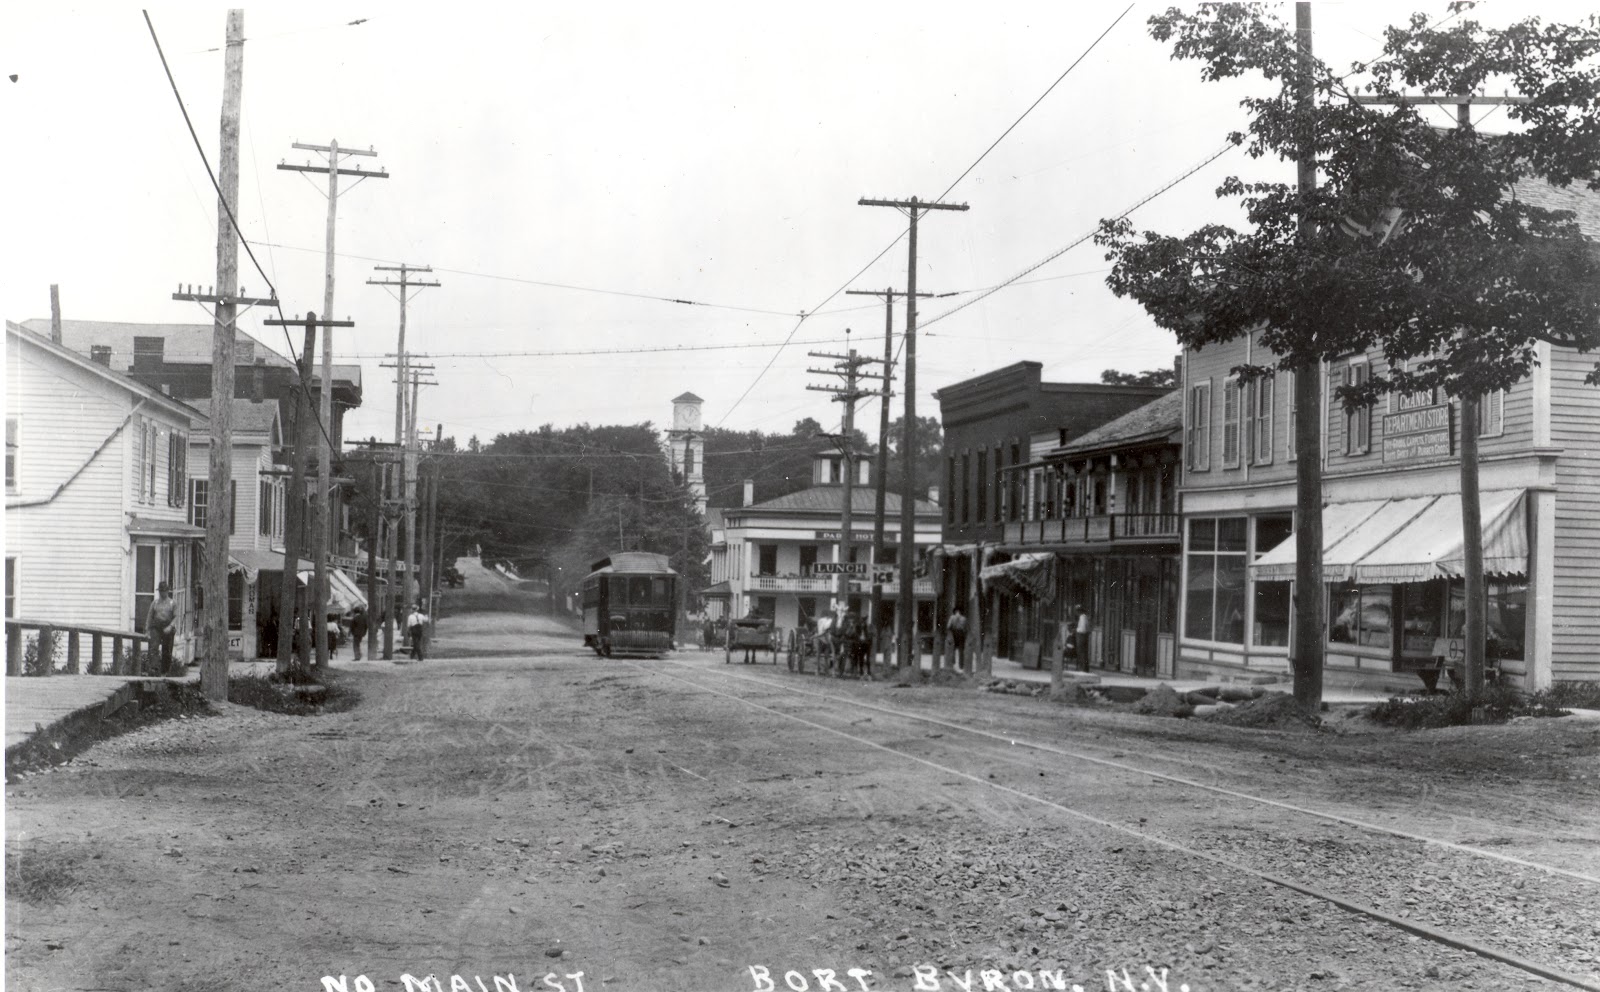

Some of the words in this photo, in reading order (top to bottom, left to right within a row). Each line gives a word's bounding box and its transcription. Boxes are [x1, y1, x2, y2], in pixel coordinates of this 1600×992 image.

[1384, 410, 1427, 434] DEPARTMENT
[1427, 406, 1448, 428] STORE
[817, 563, 864, 573] LUNCH
[873, 572, 894, 583] ICE
